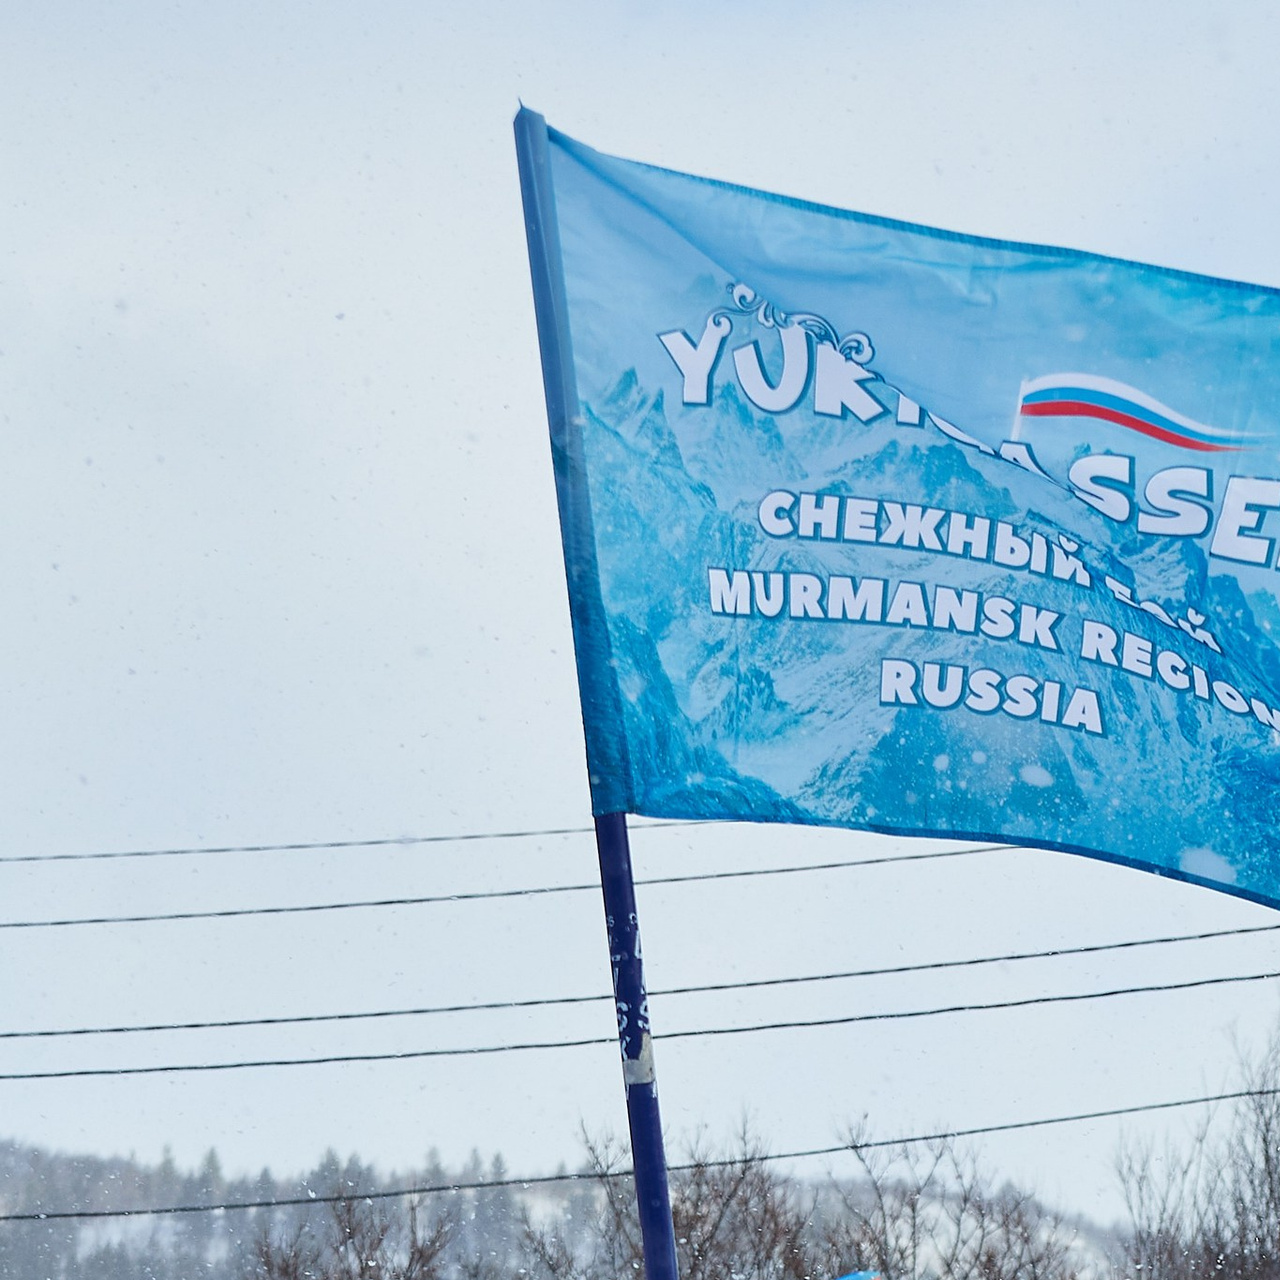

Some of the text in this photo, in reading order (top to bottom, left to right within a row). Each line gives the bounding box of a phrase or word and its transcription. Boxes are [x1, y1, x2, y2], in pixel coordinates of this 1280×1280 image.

[757, 491, 1092, 588] СНЕЖНЫЙ
[707, 567, 1062, 651] MURMANSK
[879, 658, 1105, 735] RUSSIA
